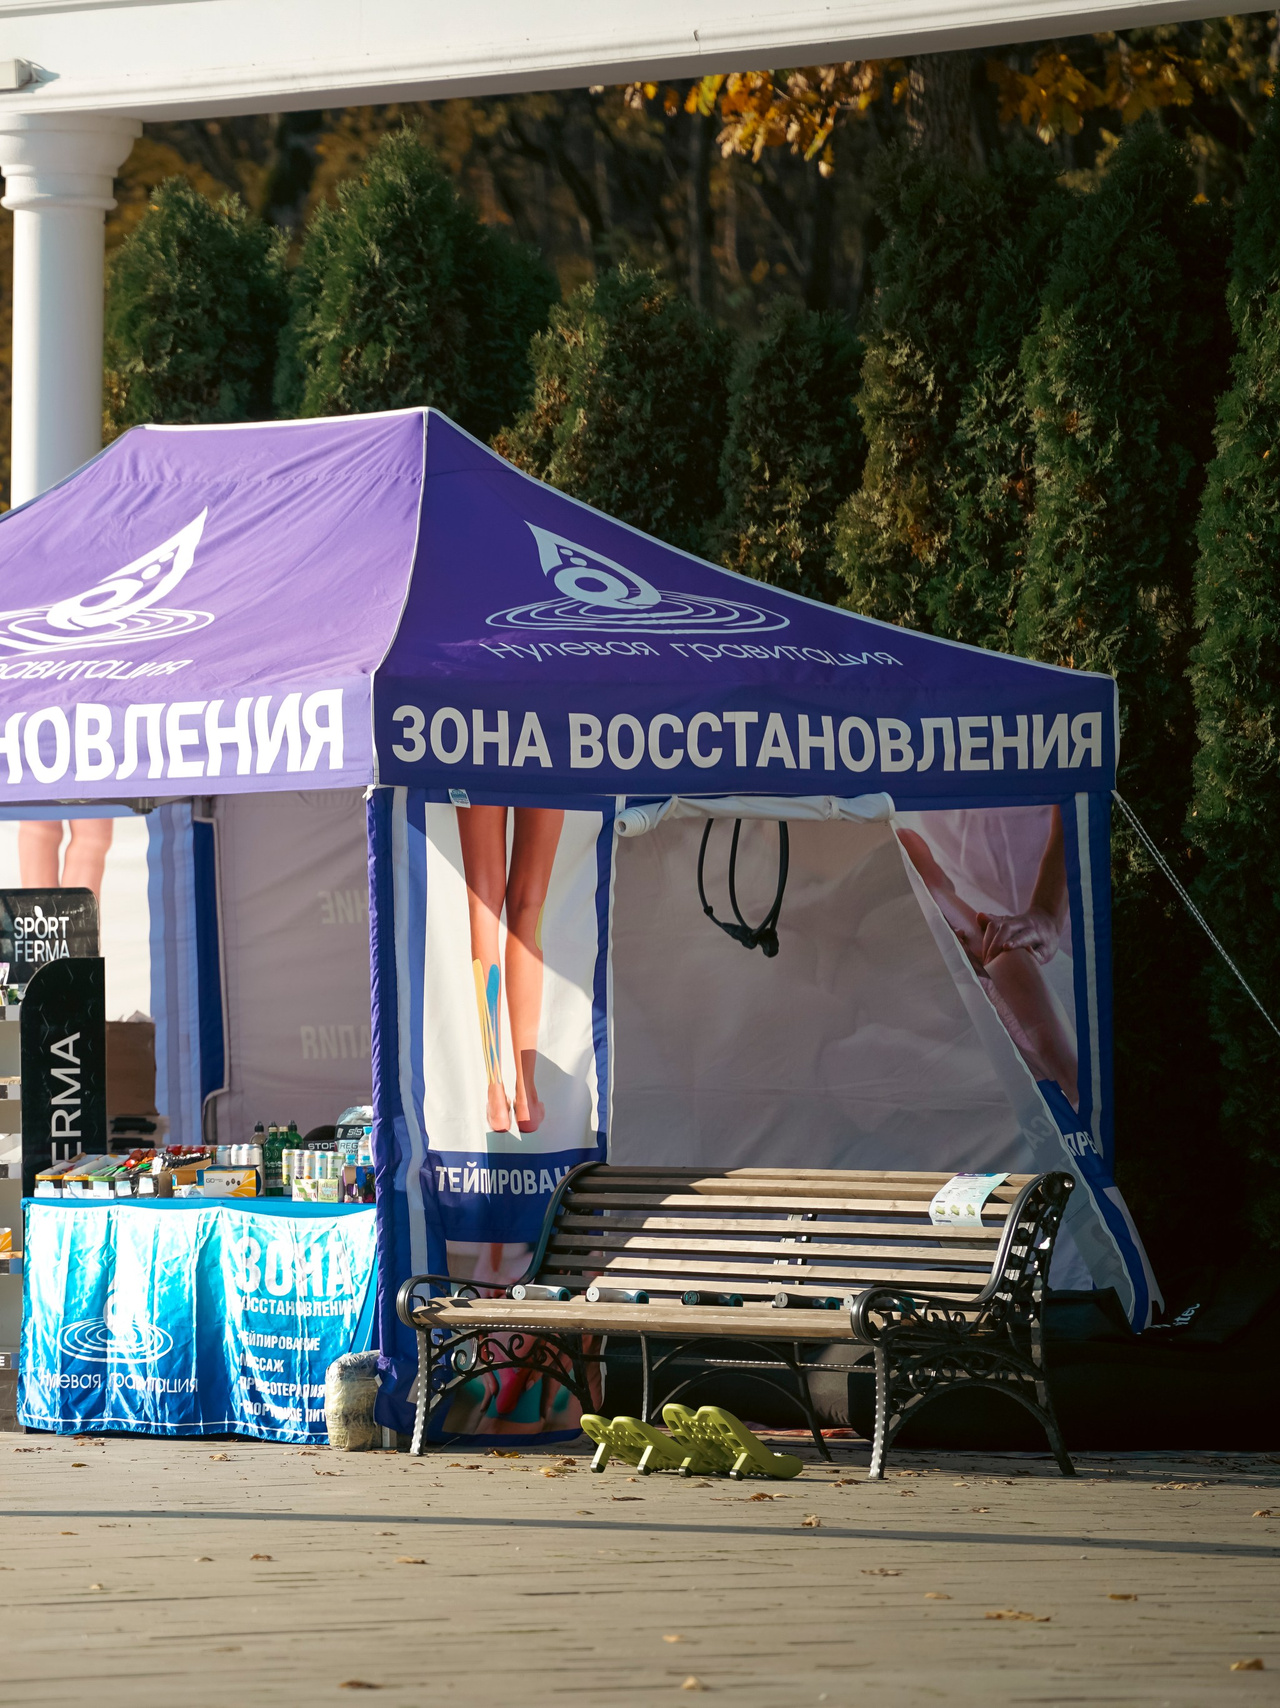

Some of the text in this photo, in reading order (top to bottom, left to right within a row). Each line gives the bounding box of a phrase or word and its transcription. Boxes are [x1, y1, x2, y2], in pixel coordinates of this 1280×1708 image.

[479, 642, 904, 666] Нулевая гравитация
[391, 705, 1103, 772] ЗОНА ВОССТАНОВЛЕНИЯ
[14, 916, 70, 939] SPORT
[14, 940, 70, 963] FERMA
[51, 1032, 82, 1166] ERMA
[234, 1237, 353, 1297] ЗОНА
